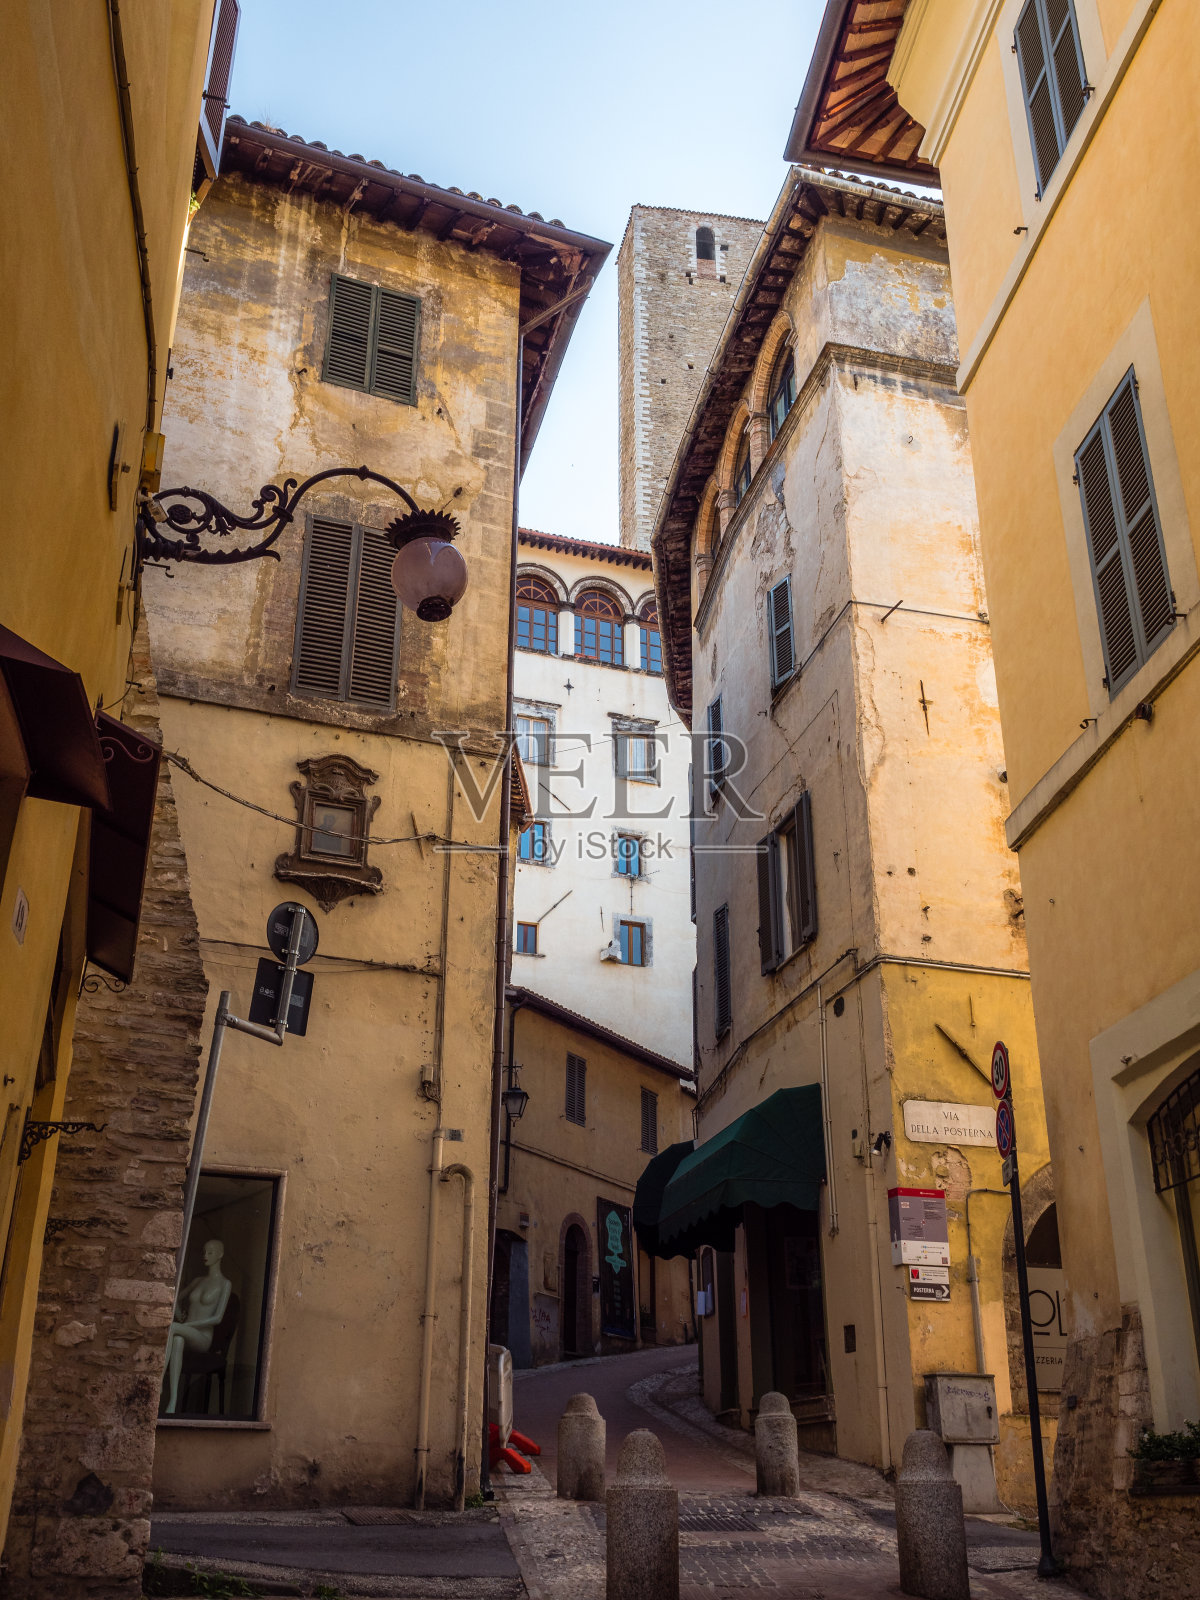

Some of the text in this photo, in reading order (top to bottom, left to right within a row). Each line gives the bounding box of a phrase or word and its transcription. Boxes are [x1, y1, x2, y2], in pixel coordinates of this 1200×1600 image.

[994, 1056, 1004, 1085] 30
[943, 1111, 960, 1121] VIA
[911, 1124, 994, 1139] DELLA POSTERNA
[1036, 1356, 1063, 1365] ZZERIA
